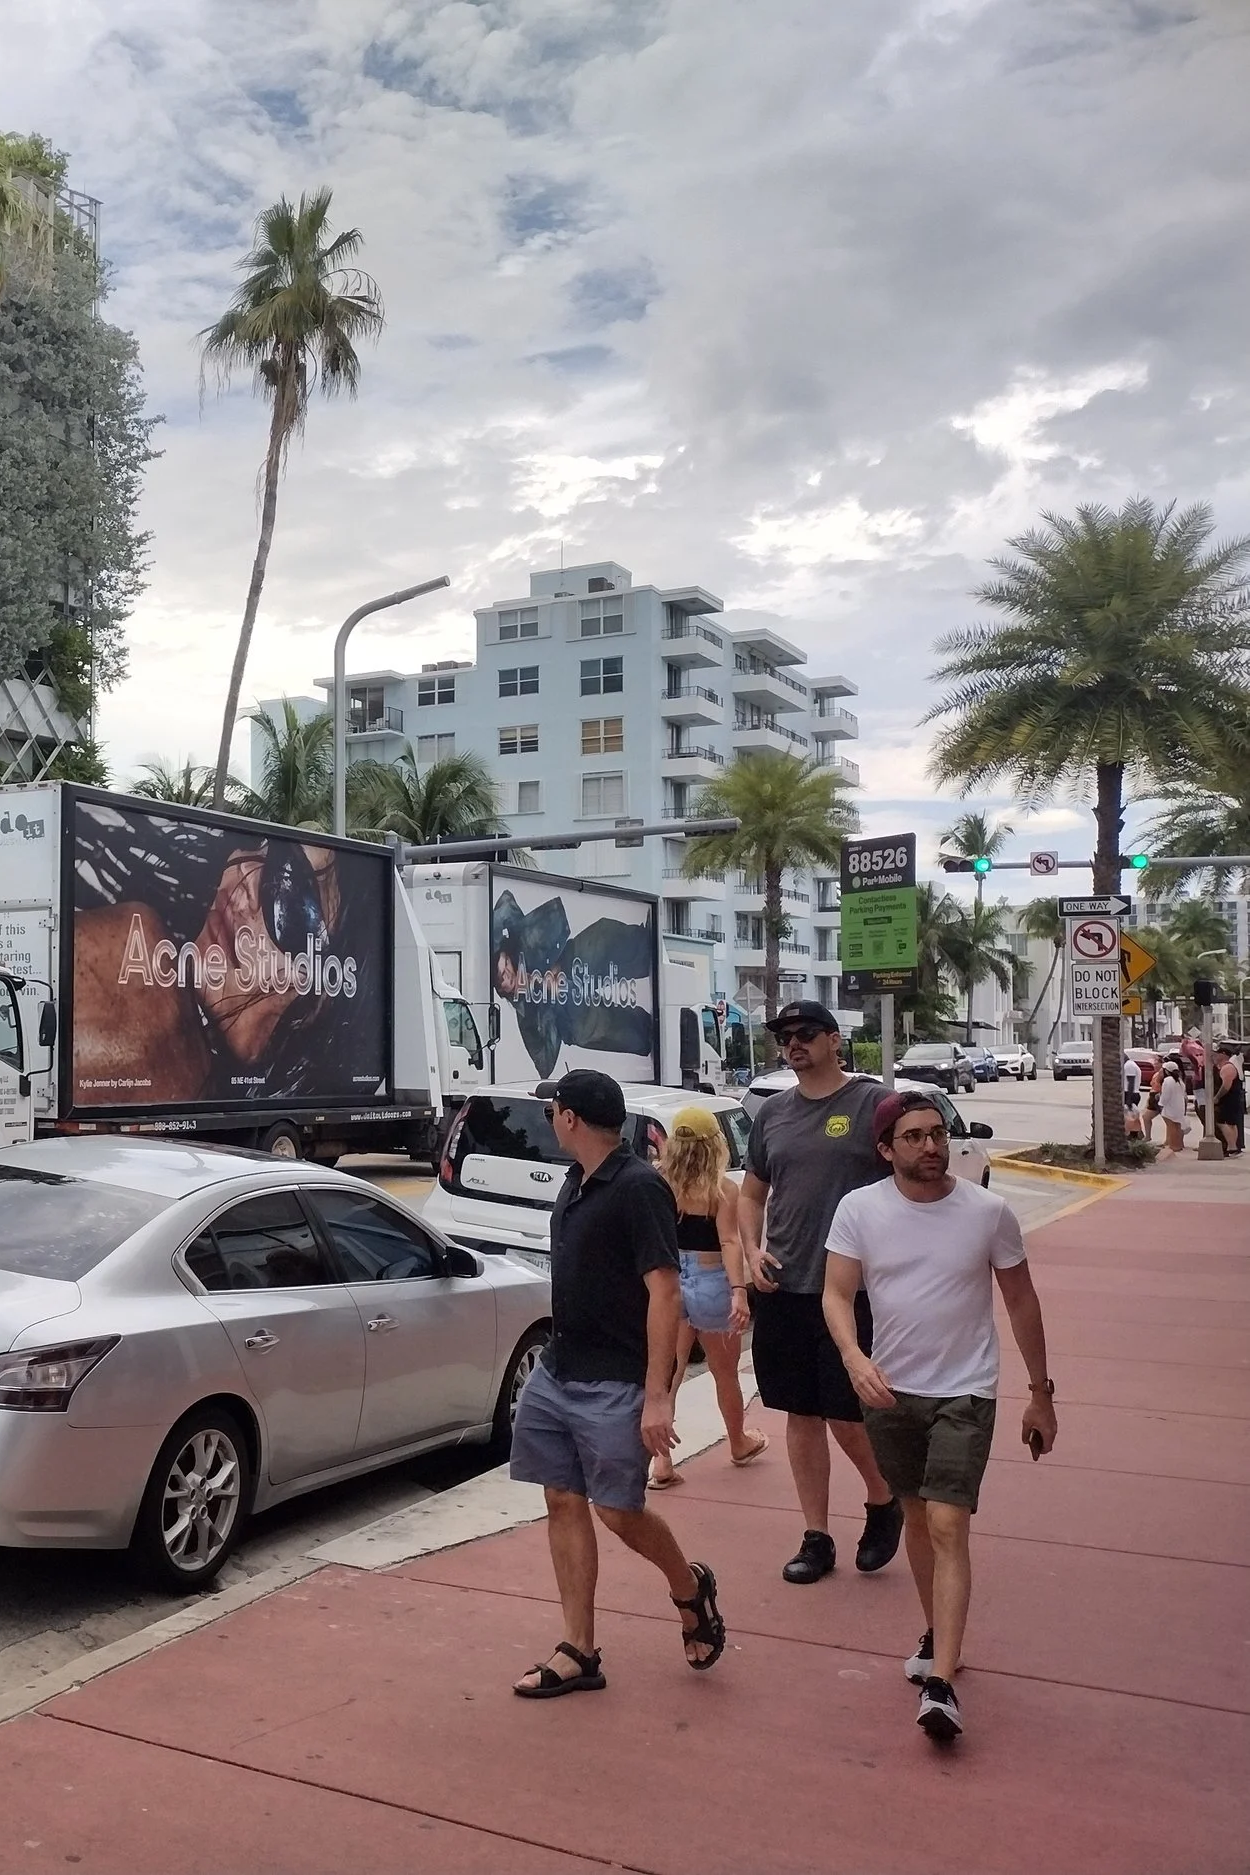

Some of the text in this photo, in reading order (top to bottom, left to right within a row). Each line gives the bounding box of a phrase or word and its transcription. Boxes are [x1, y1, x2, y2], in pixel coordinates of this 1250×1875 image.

[848, 846, 908, 874] 88526
[862, 873, 903, 886] ParkMobile
[849, 902, 907, 915] Parking Payments
[1065, 902, 1109, 911] ONE WAY
[6, 923, 26, 935] this
[6, 939, 13, 949] a
[117, 913, 357, 998] Acne Studios
[9, 964, 42, 975] test...
[514, 951, 637, 1010] Acne Studios
[1074, 970, 1118, 982] DO NOT
[1075, 987, 1119, 999] BLOCK
[1075, 1002, 1119, 1011] INTERSECTION
[79, 1079, 93, 1090] Kylie
[110, 1078, 118, 1089] by
[533, 1172, 549, 1181] KIA
